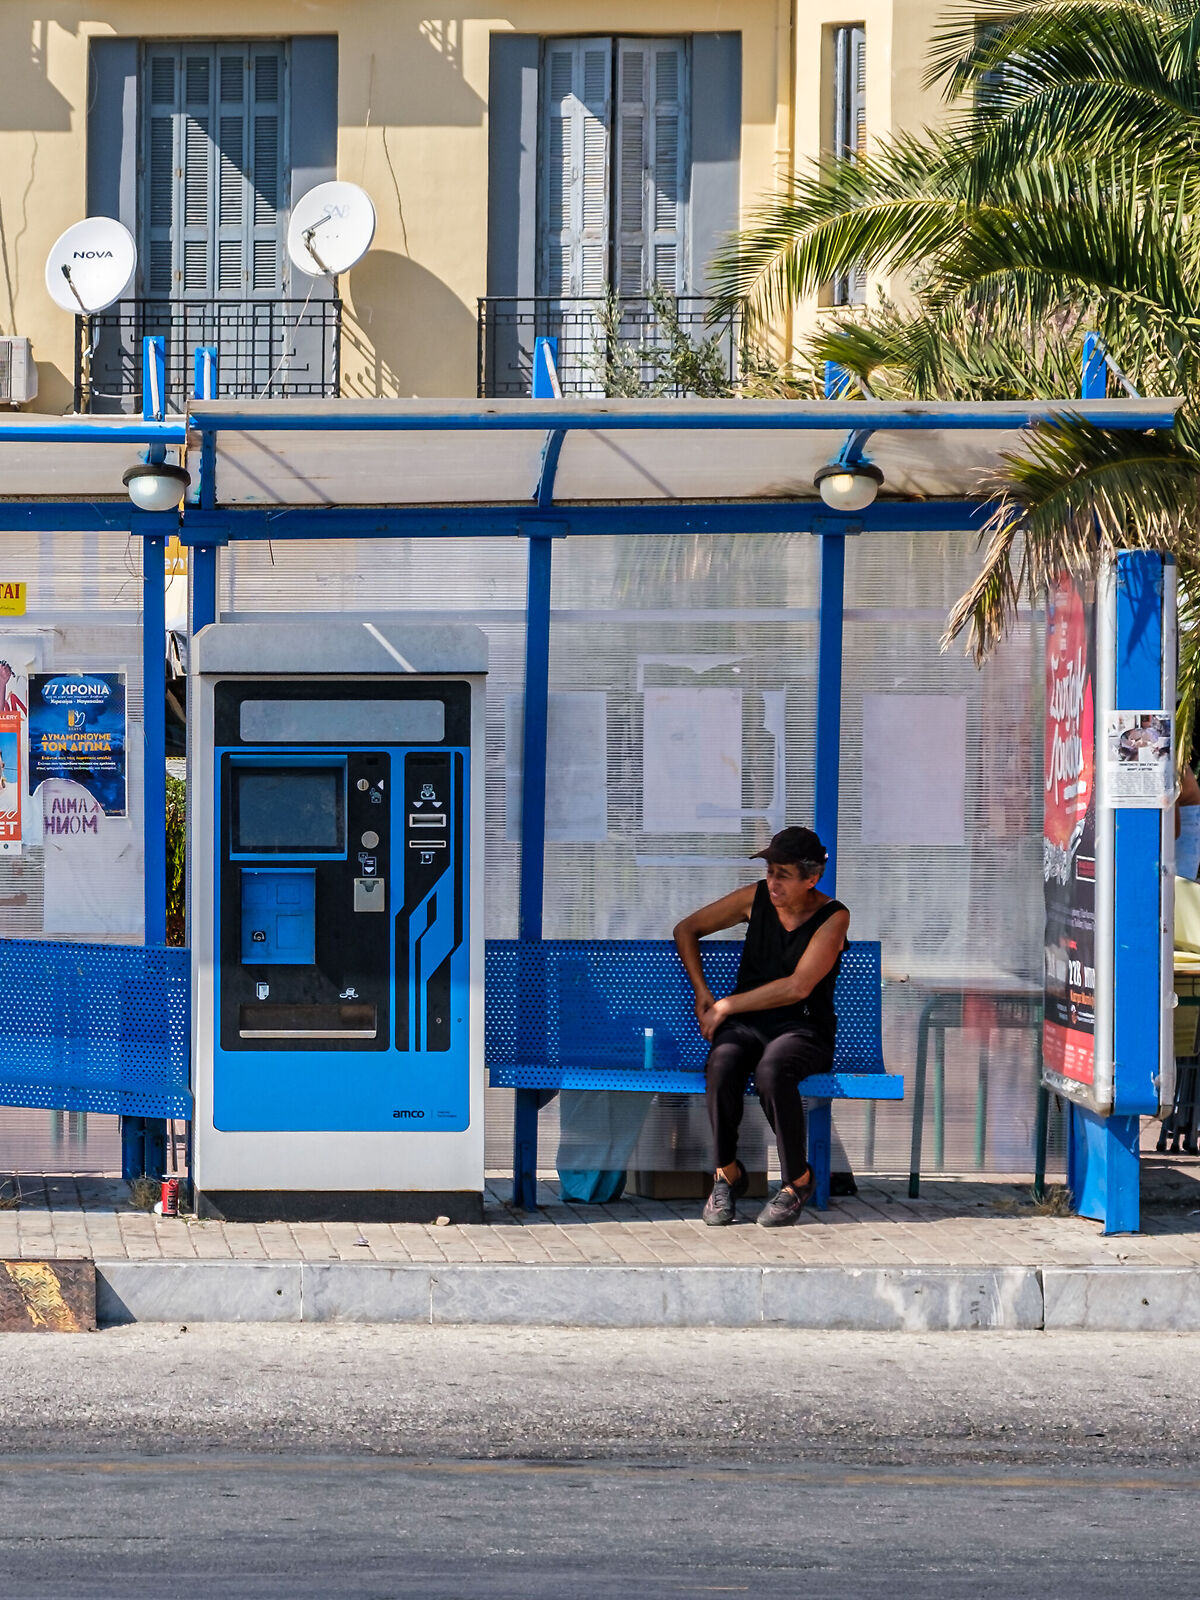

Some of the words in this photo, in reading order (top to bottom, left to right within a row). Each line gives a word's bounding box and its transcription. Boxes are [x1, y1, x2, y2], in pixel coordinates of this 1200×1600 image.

[73, 250, 114, 260] NOVA
[43, 684, 59, 696] 77
[61, 684, 110, 696] ΧΡΟΝΙΑ
[41, 733, 111, 741] ΔΥΝΑΜΩΝΟΥΜΕ
[41, 742, 67, 751] ΤΟΝ
[70, 742, 111, 751] ΑΓΩΝΑ
[392, 1110, 425, 1118] amco
